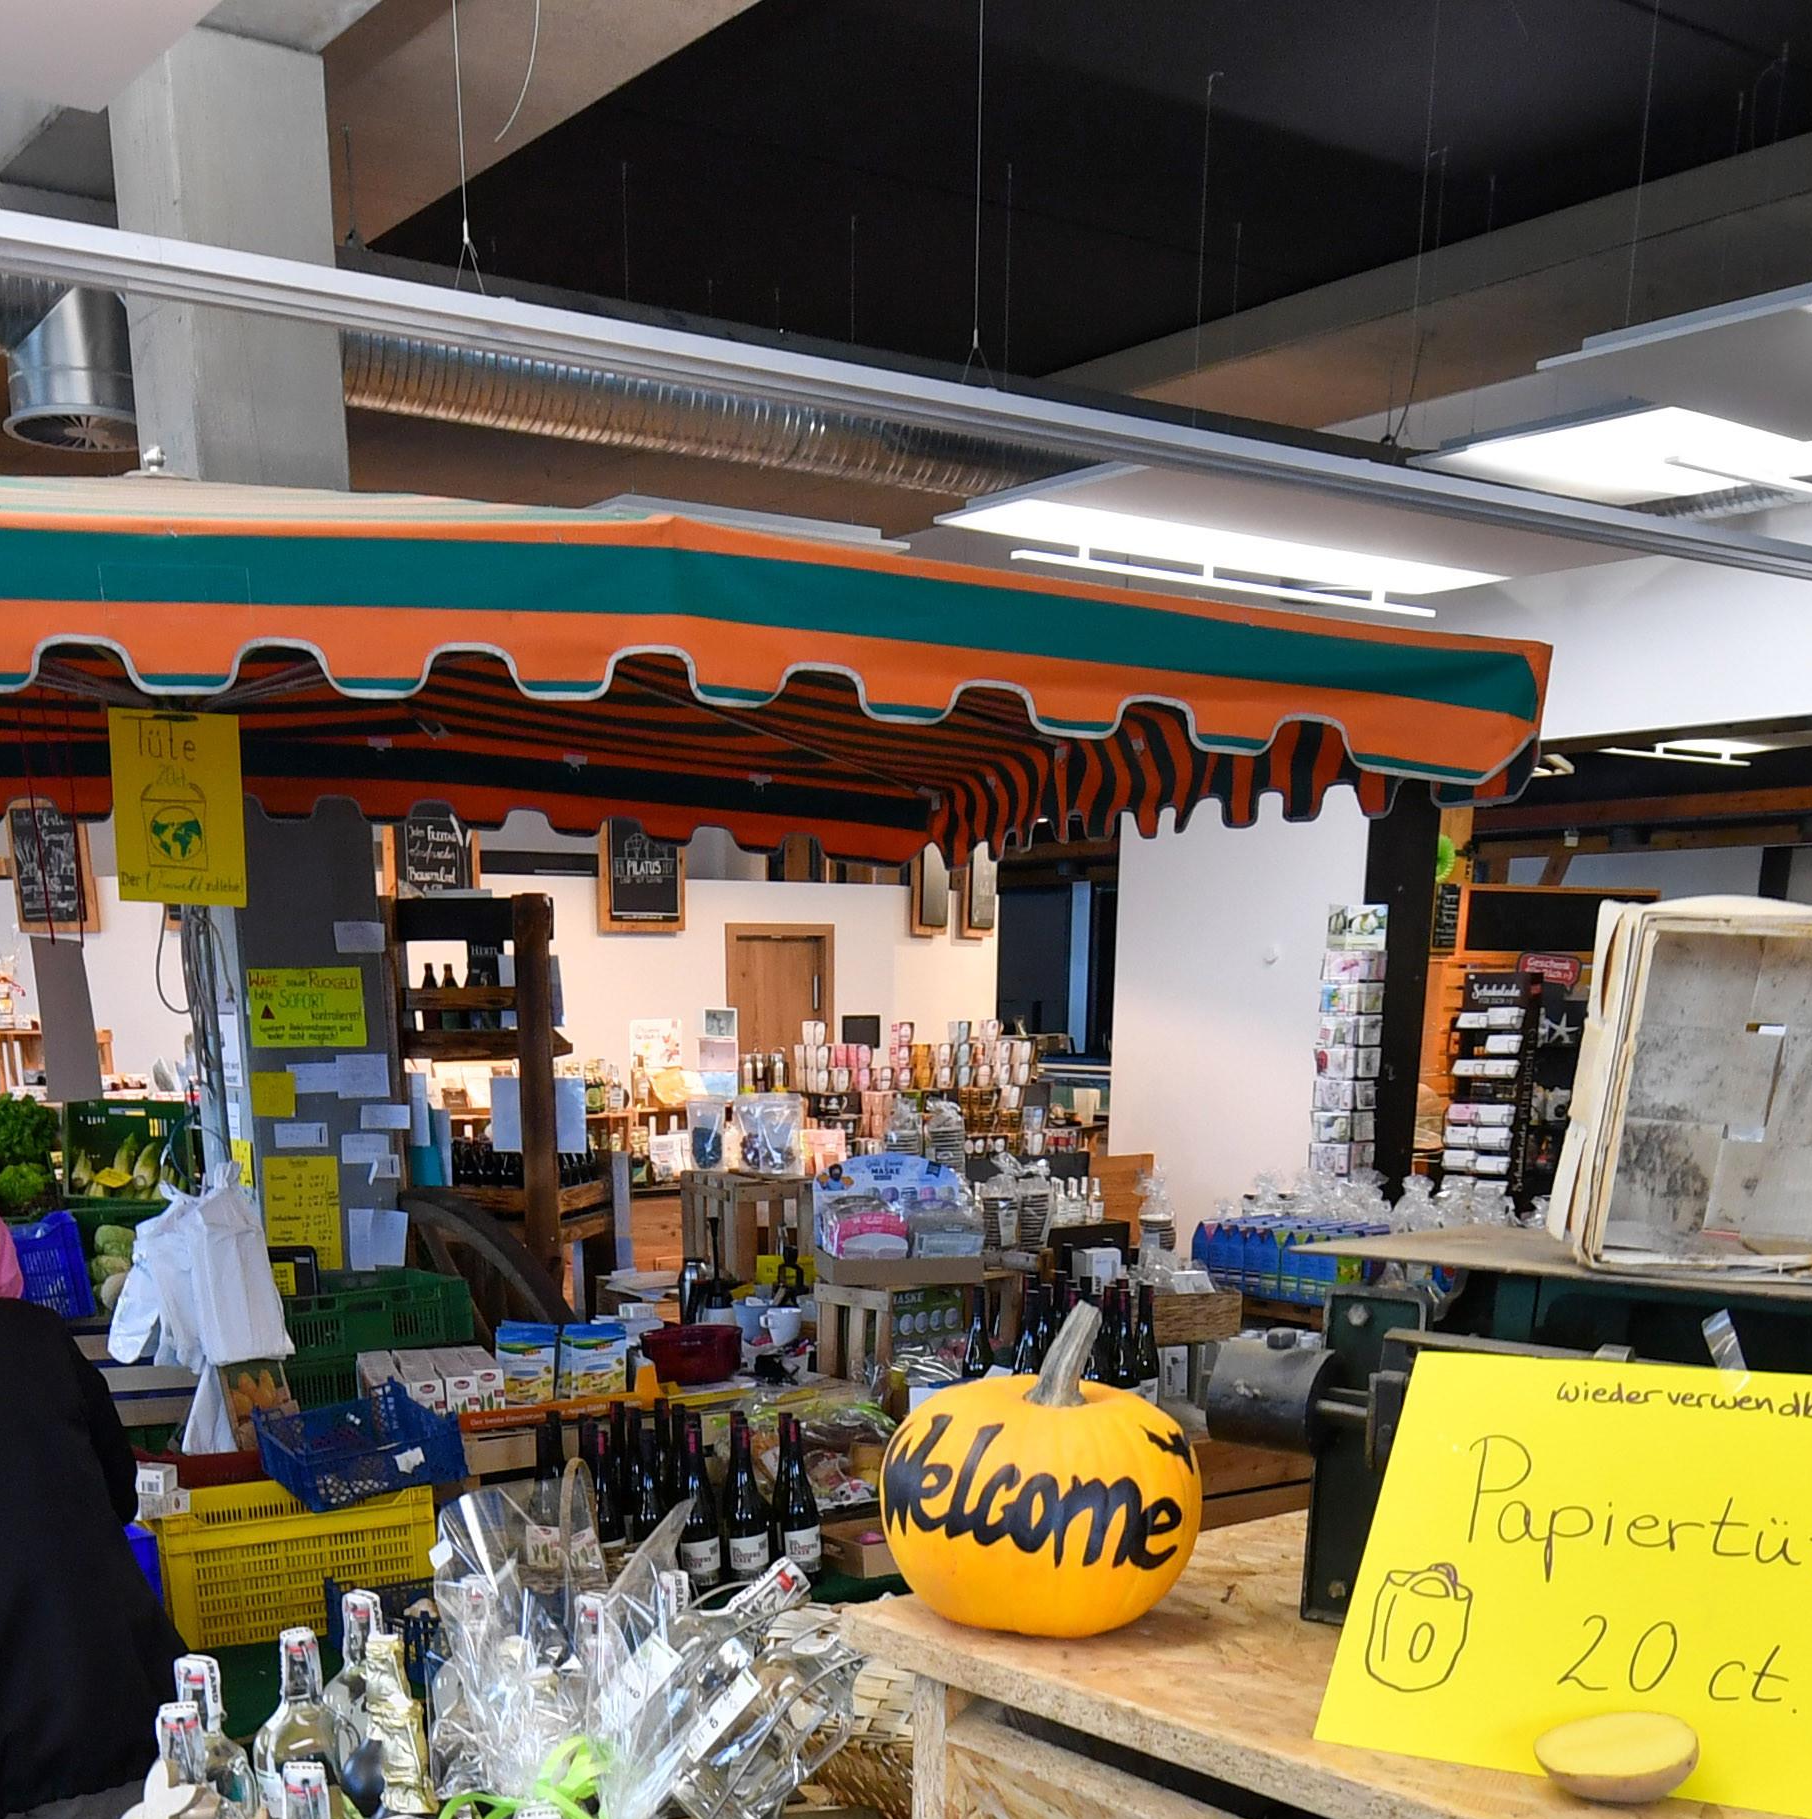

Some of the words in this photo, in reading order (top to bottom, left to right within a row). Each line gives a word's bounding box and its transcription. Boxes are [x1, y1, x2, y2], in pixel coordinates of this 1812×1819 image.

[121, 713, 196, 762] Tüte
[870, 1167, 901, 1176] MASKE
[884, 1413, 1182, 1571] Welcome
[1555, 1614, 1679, 1693] 20
